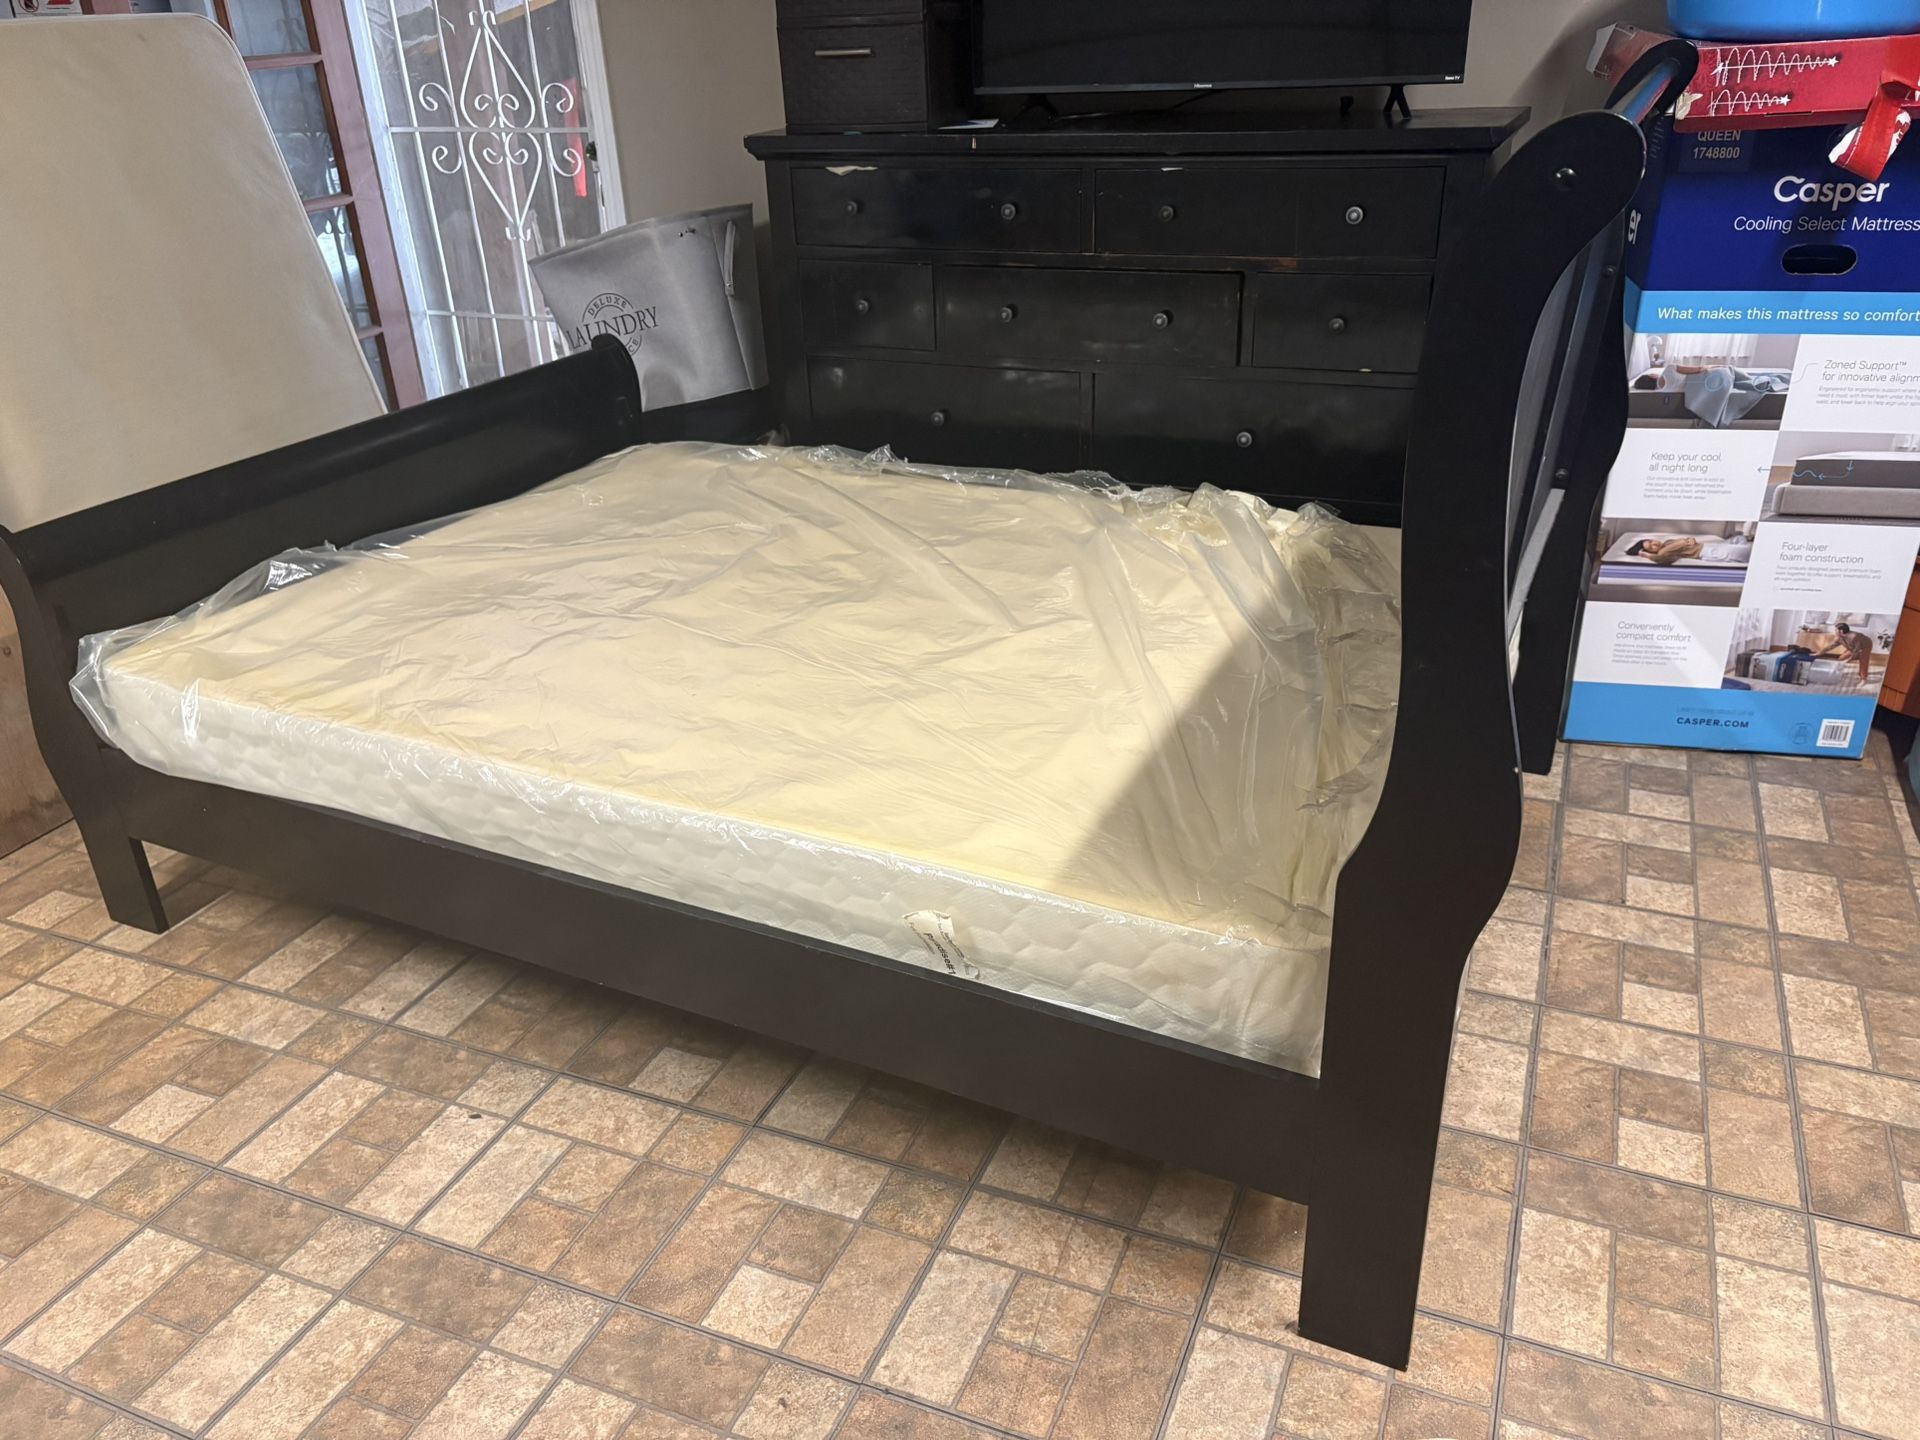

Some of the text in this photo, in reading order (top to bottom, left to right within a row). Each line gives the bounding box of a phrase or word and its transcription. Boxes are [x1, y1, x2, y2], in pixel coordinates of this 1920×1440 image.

[1697, 130, 1741, 141] QUEEN
[1693, 147, 1741, 159] 1748800
[1773, 175, 1890, 212] Casper
[1734, 216, 1920, 234] Cooling Select Mattress
[587, 296, 628, 316] DELUXE
[1658, 307, 1693, 320] What
[1699, 307, 1741, 320] makes
[1746, 307, 1771, 320] this
[1776, 308, 1838, 321] mattress
[1842, 311, 1860, 321] so
[1824, 359, 1857, 370] Zoned
[1822, 371, 1836, 381] for
[1838, 372, 1888, 382] innovative
[1651, 452, 1722, 463] Keep your cool
[1649, 463, 1709, 474] all night long
[1781, 541, 1829, 553] Four-layer
[1779, 552, 1865, 564] foam construction
[1617, 620, 1676, 633] Conveniently
[1615, 631, 1692, 643] compact comfort
[1676, 717, 1750, 729] CASPER.COM
